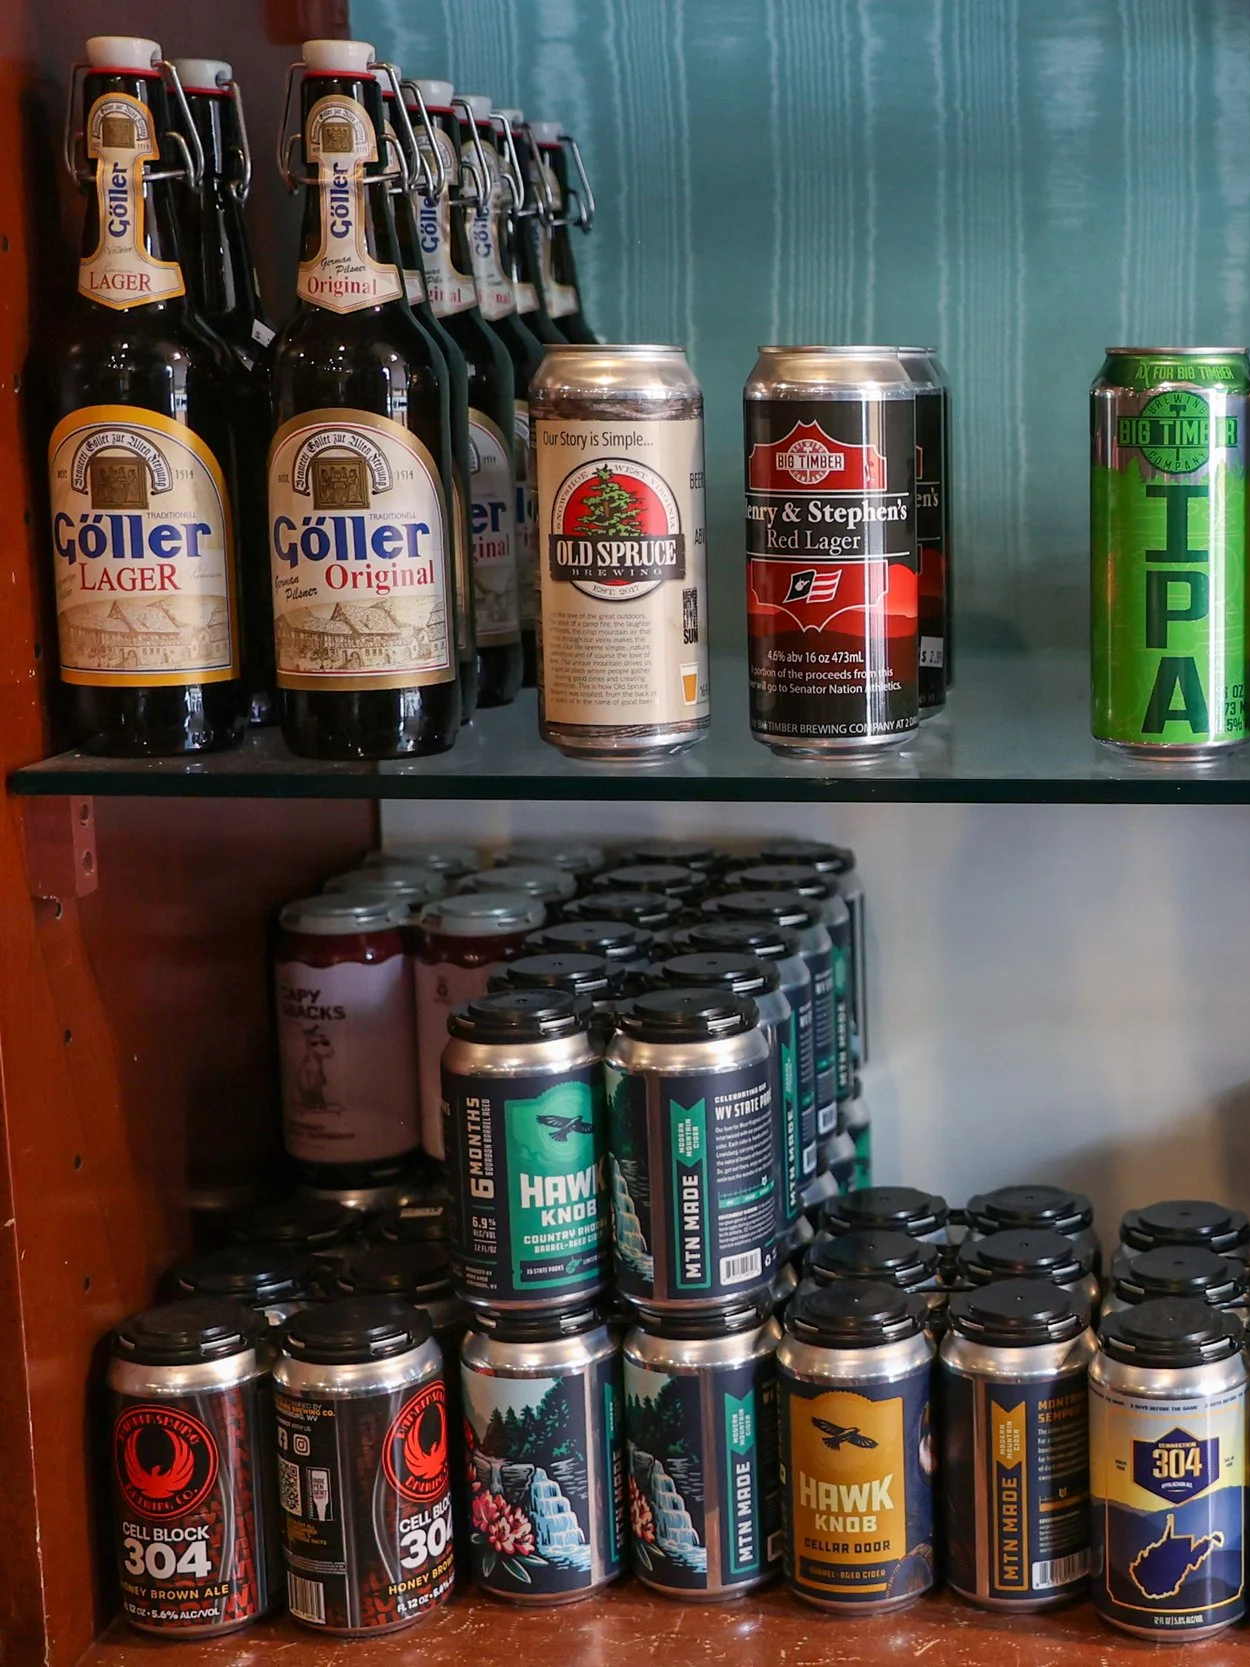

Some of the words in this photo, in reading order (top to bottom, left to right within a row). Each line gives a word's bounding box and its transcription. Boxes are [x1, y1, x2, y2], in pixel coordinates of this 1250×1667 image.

[107, 161, 132, 238] Göller
[330, 162, 353, 239] Göller
[89, 272, 151, 291] LAGER
[307, 276, 377, 298] Original
[1198, 366, 1234, 379] TIMBER
[1148, 394, 1205, 414] BREWING
[332, 432, 346, 445] zur
[560, 431, 587, 449] Story
[602, 432, 653, 450] Simple...
[1120, 419, 1151, 445] BIG
[778, 455, 794, 468] BIG
[799, 455, 842, 468] TIMBER
[1148, 451, 1206, 471] COMPANY
[557, 472, 589, 530] SNOWSHOE
[782, 502, 801, 522] &
[808, 499, 908, 529] Stephen's
[54, 510, 212, 567] Göller
[274, 514, 430, 570] Göller
[767, 530, 799, 549] Red
[805, 531, 861, 555] Lager
[557, 540, 592, 567] OLD
[597, 540, 676, 566] SPRUCE
[80, 562, 182, 592] LAGER
[325, 559, 436, 597] Original
[572, 569, 662, 577] BREWING
[787, 651, 803, 663] abv
[805, 652, 816, 663] 16
[818, 654, 830, 663] oz
[832, 652, 864, 663] 473mL
[805, 669, 852, 682] proceeds
[789, 684, 825, 694] Senator
[828, 684, 863, 694] Nation
[769, 721, 798, 734] TIMBER
[800, 722, 847, 735] BREWING
[714, 1088, 757, 1103] CELEBRATING
[482, 1098, 491, 1117] AGED
[734, 1098, 759, 1117] STATE
[466, 1097, 483, 1175] MONTHS
[482, 1117, 493, 1144] BARREL
[483, 1143, 495, 1176] BOURBON
[471, 1178, 495, 1200] 6
[541, 1200, 597, 1227] KNOB
[682, 1175, 700, 1232] MADE
[523, 1228, 577, 1245] COUNTRY
[685, 1235, 702, 1280] MTN
[1152, 1448, 1203, 1479] 304
[736, 1461, 751, 1516] MADE
[800, 1470, 894, 1513] HAWK
[1001, 1477, 1018, 1532] MADE
[122, 1521, 150, 1541] CELL
[153, 1525, 210, 1543] BLOCK
[400, 1515, 431, 1534] CELL
[815, 1513, 878, 1533] KNOB
[739, 1518, 753, 1563] MTN
[804, 1537, 849, 1554] CELLAR
[854, 1539, 891, 1554] DOOR
[124, 1537, 212, 1579] 304
[1003, 1539, 1019, 1580] MTN
[150, 1586, 200, 1600] BROWN
[204, 1583, 230, 1597] ALE
[388, 1573, 429, 1595] HONEY
[151, 1609, 179, 1620] 5.6%
[180, 1607, 220, 1620] ALC/VOL
